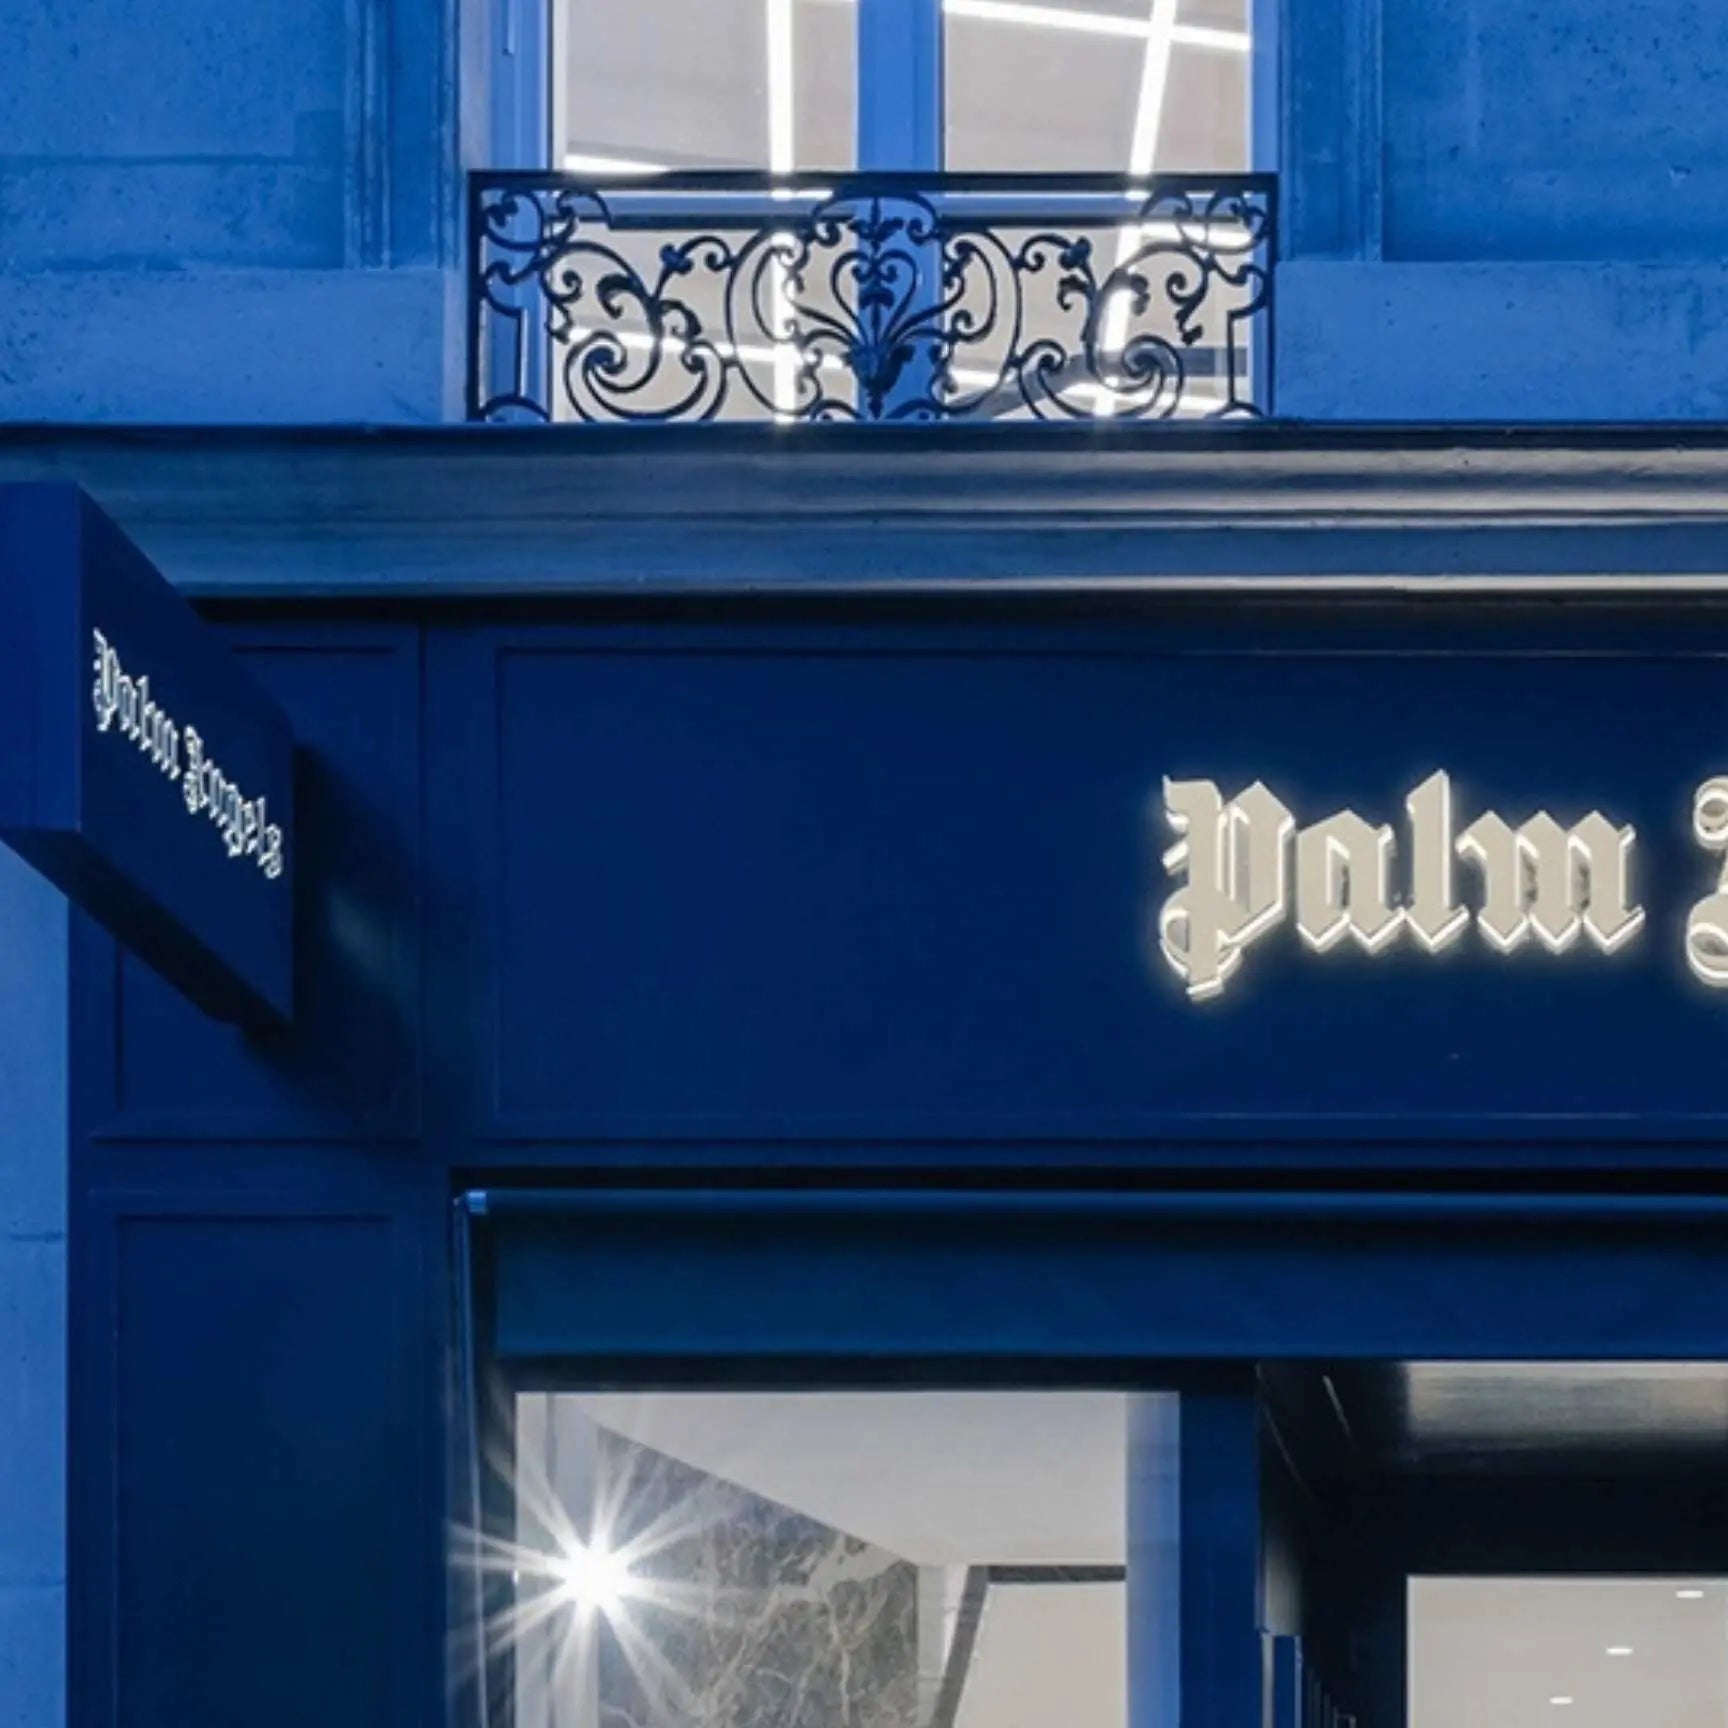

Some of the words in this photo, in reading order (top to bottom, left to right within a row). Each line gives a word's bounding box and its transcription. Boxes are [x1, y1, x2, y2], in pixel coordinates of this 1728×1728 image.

[93, 627, 181, 781] Palm
[183, 725, 283, 880] Angels
[1160, 769, 1647, 1001] Palm
